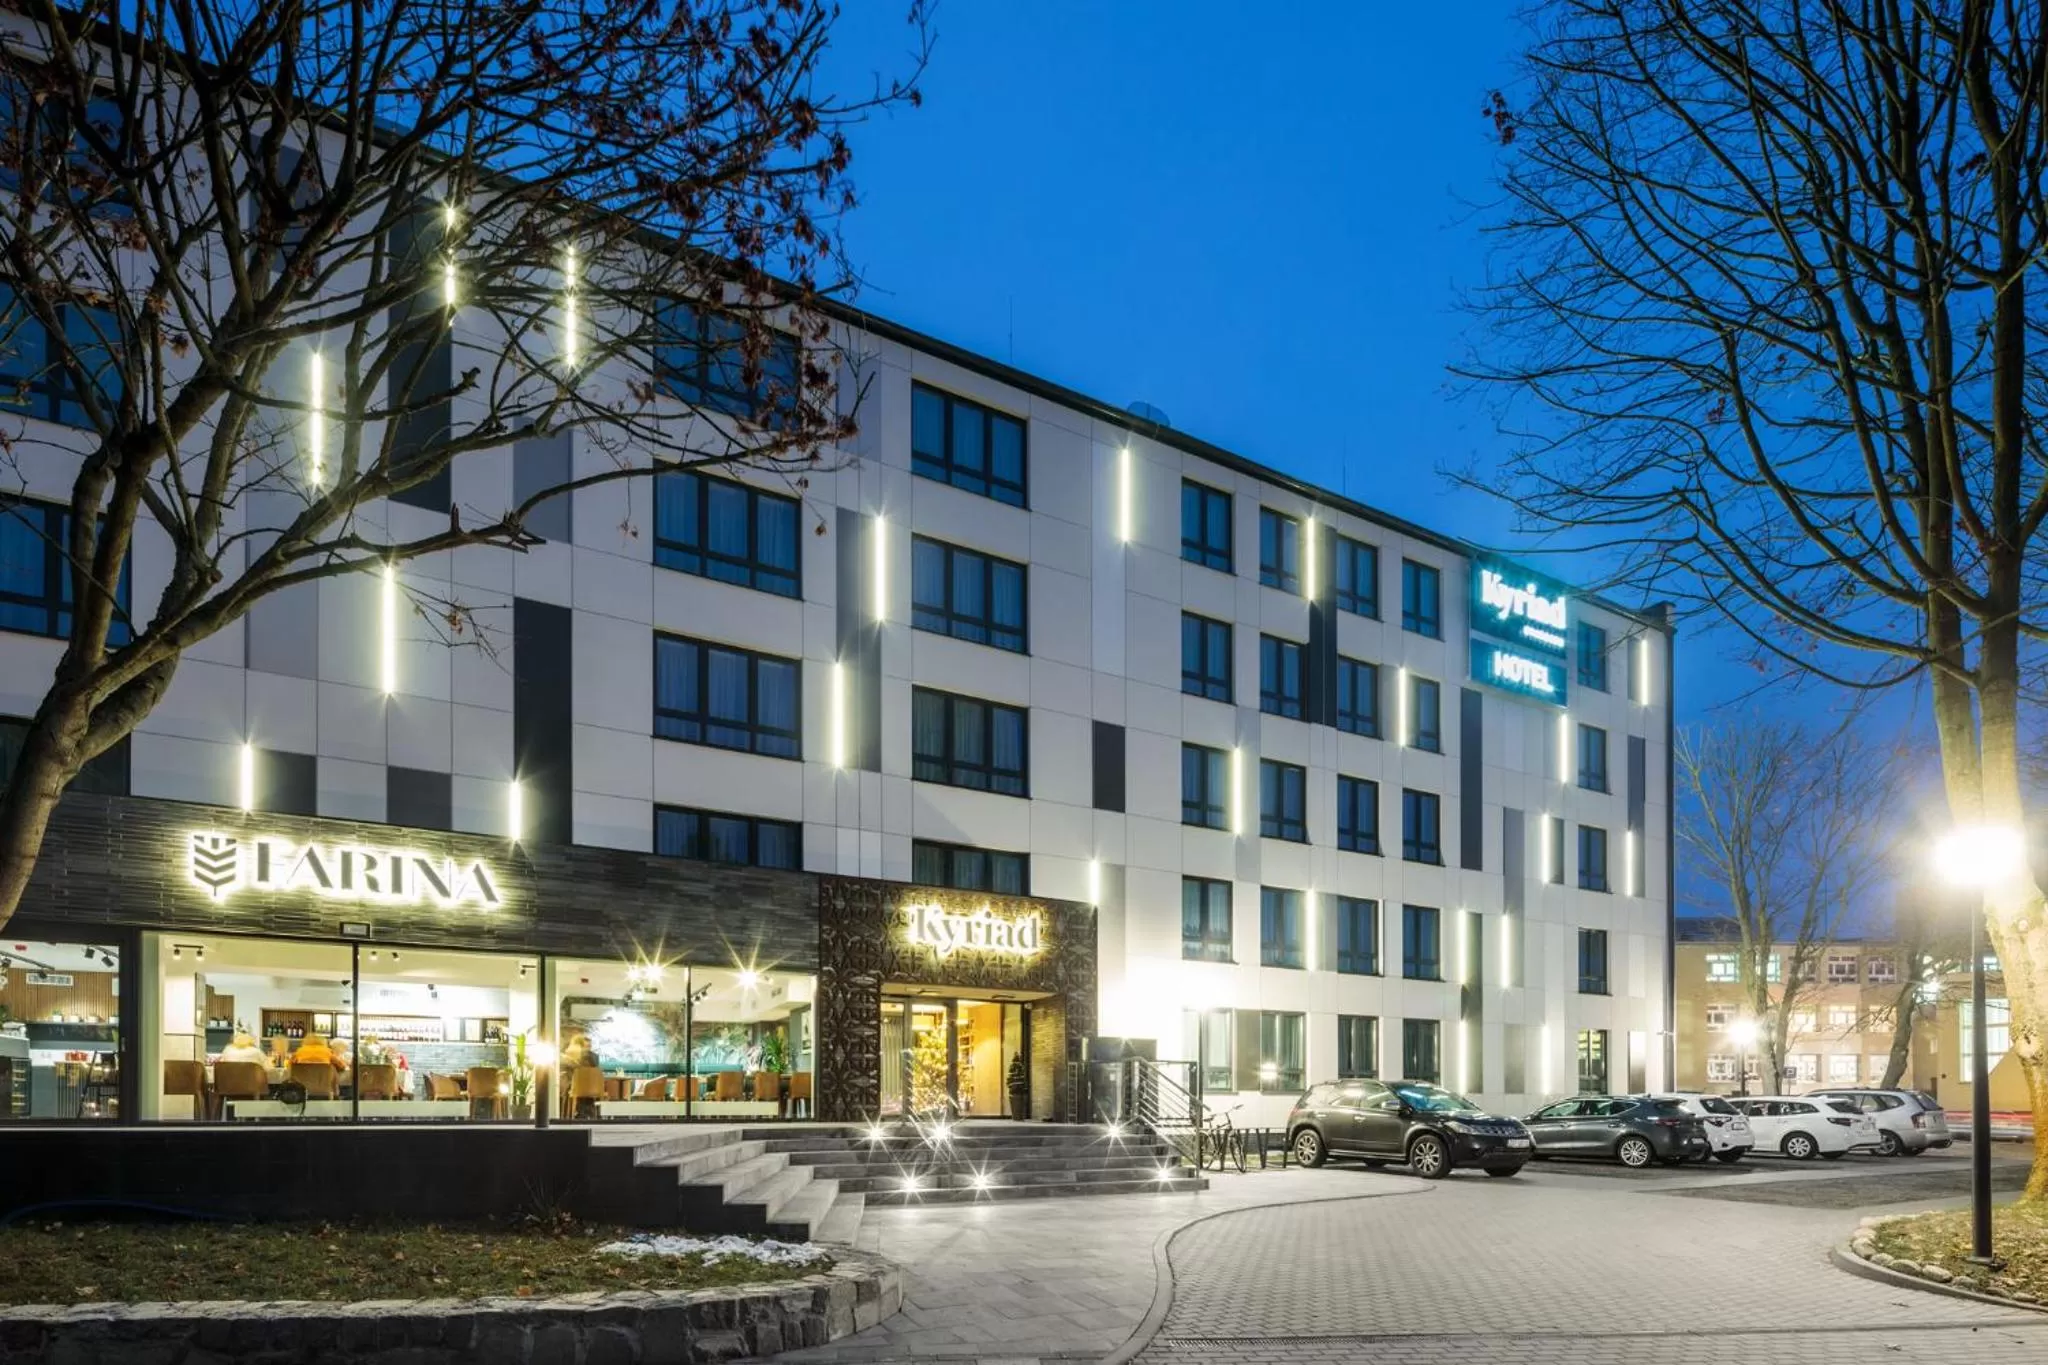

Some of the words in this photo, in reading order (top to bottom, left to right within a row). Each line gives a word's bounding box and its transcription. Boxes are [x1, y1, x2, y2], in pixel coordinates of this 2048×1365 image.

[1482, 569, 1567, 629] Kyriad
[1494, 651, 1555, 693] HOTEL
[256, 840, 499, 904] FARINA
[909, 905, 1040, 954] Kyriad
